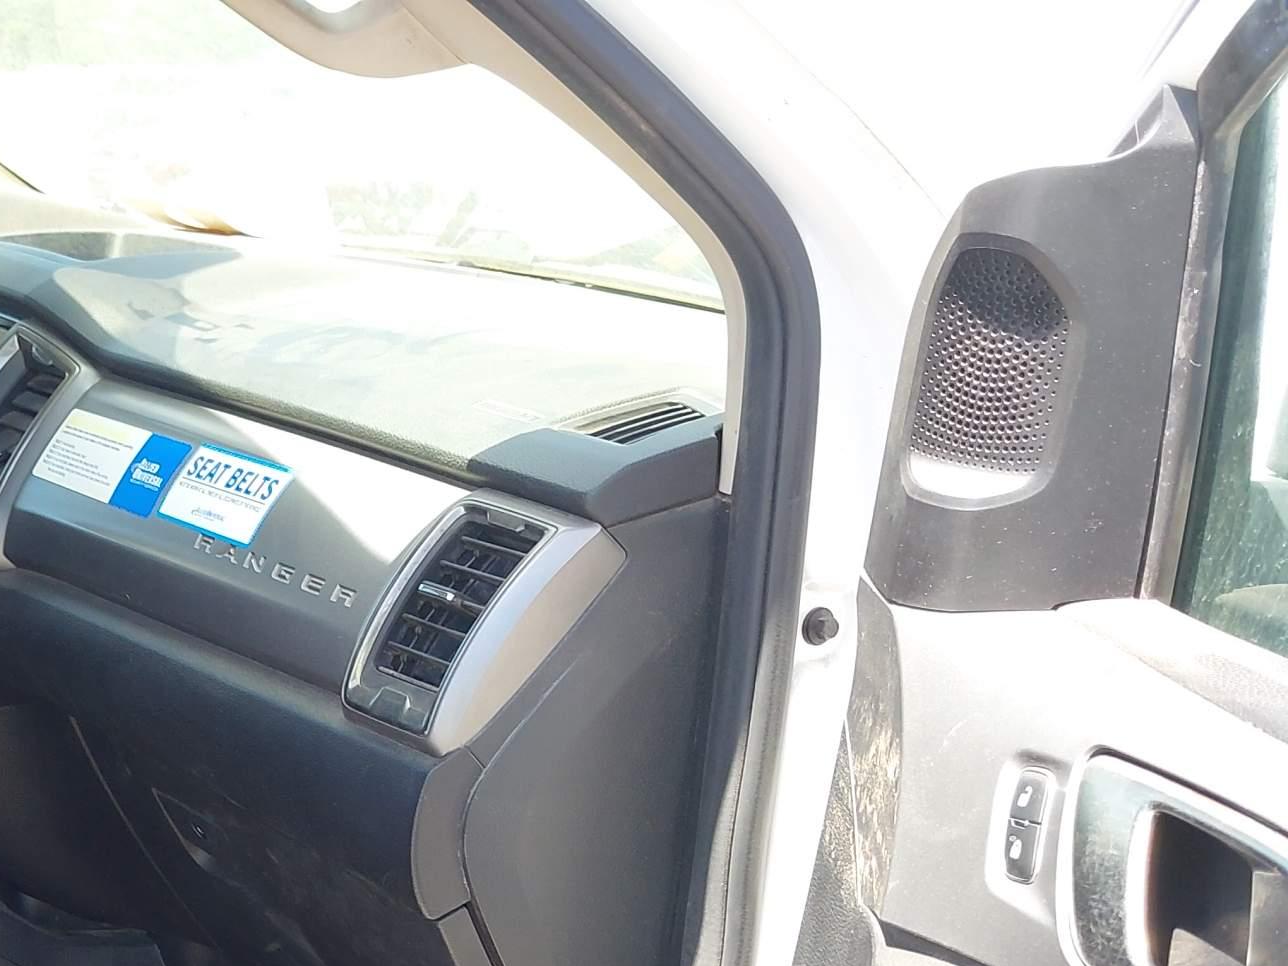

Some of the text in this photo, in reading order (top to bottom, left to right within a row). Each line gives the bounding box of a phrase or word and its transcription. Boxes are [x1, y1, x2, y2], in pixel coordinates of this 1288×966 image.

[187, 456, 231, 484] SEAT
[225, 467, 280, 501] BELTS
[193, 532, 358, 608] RANGER
